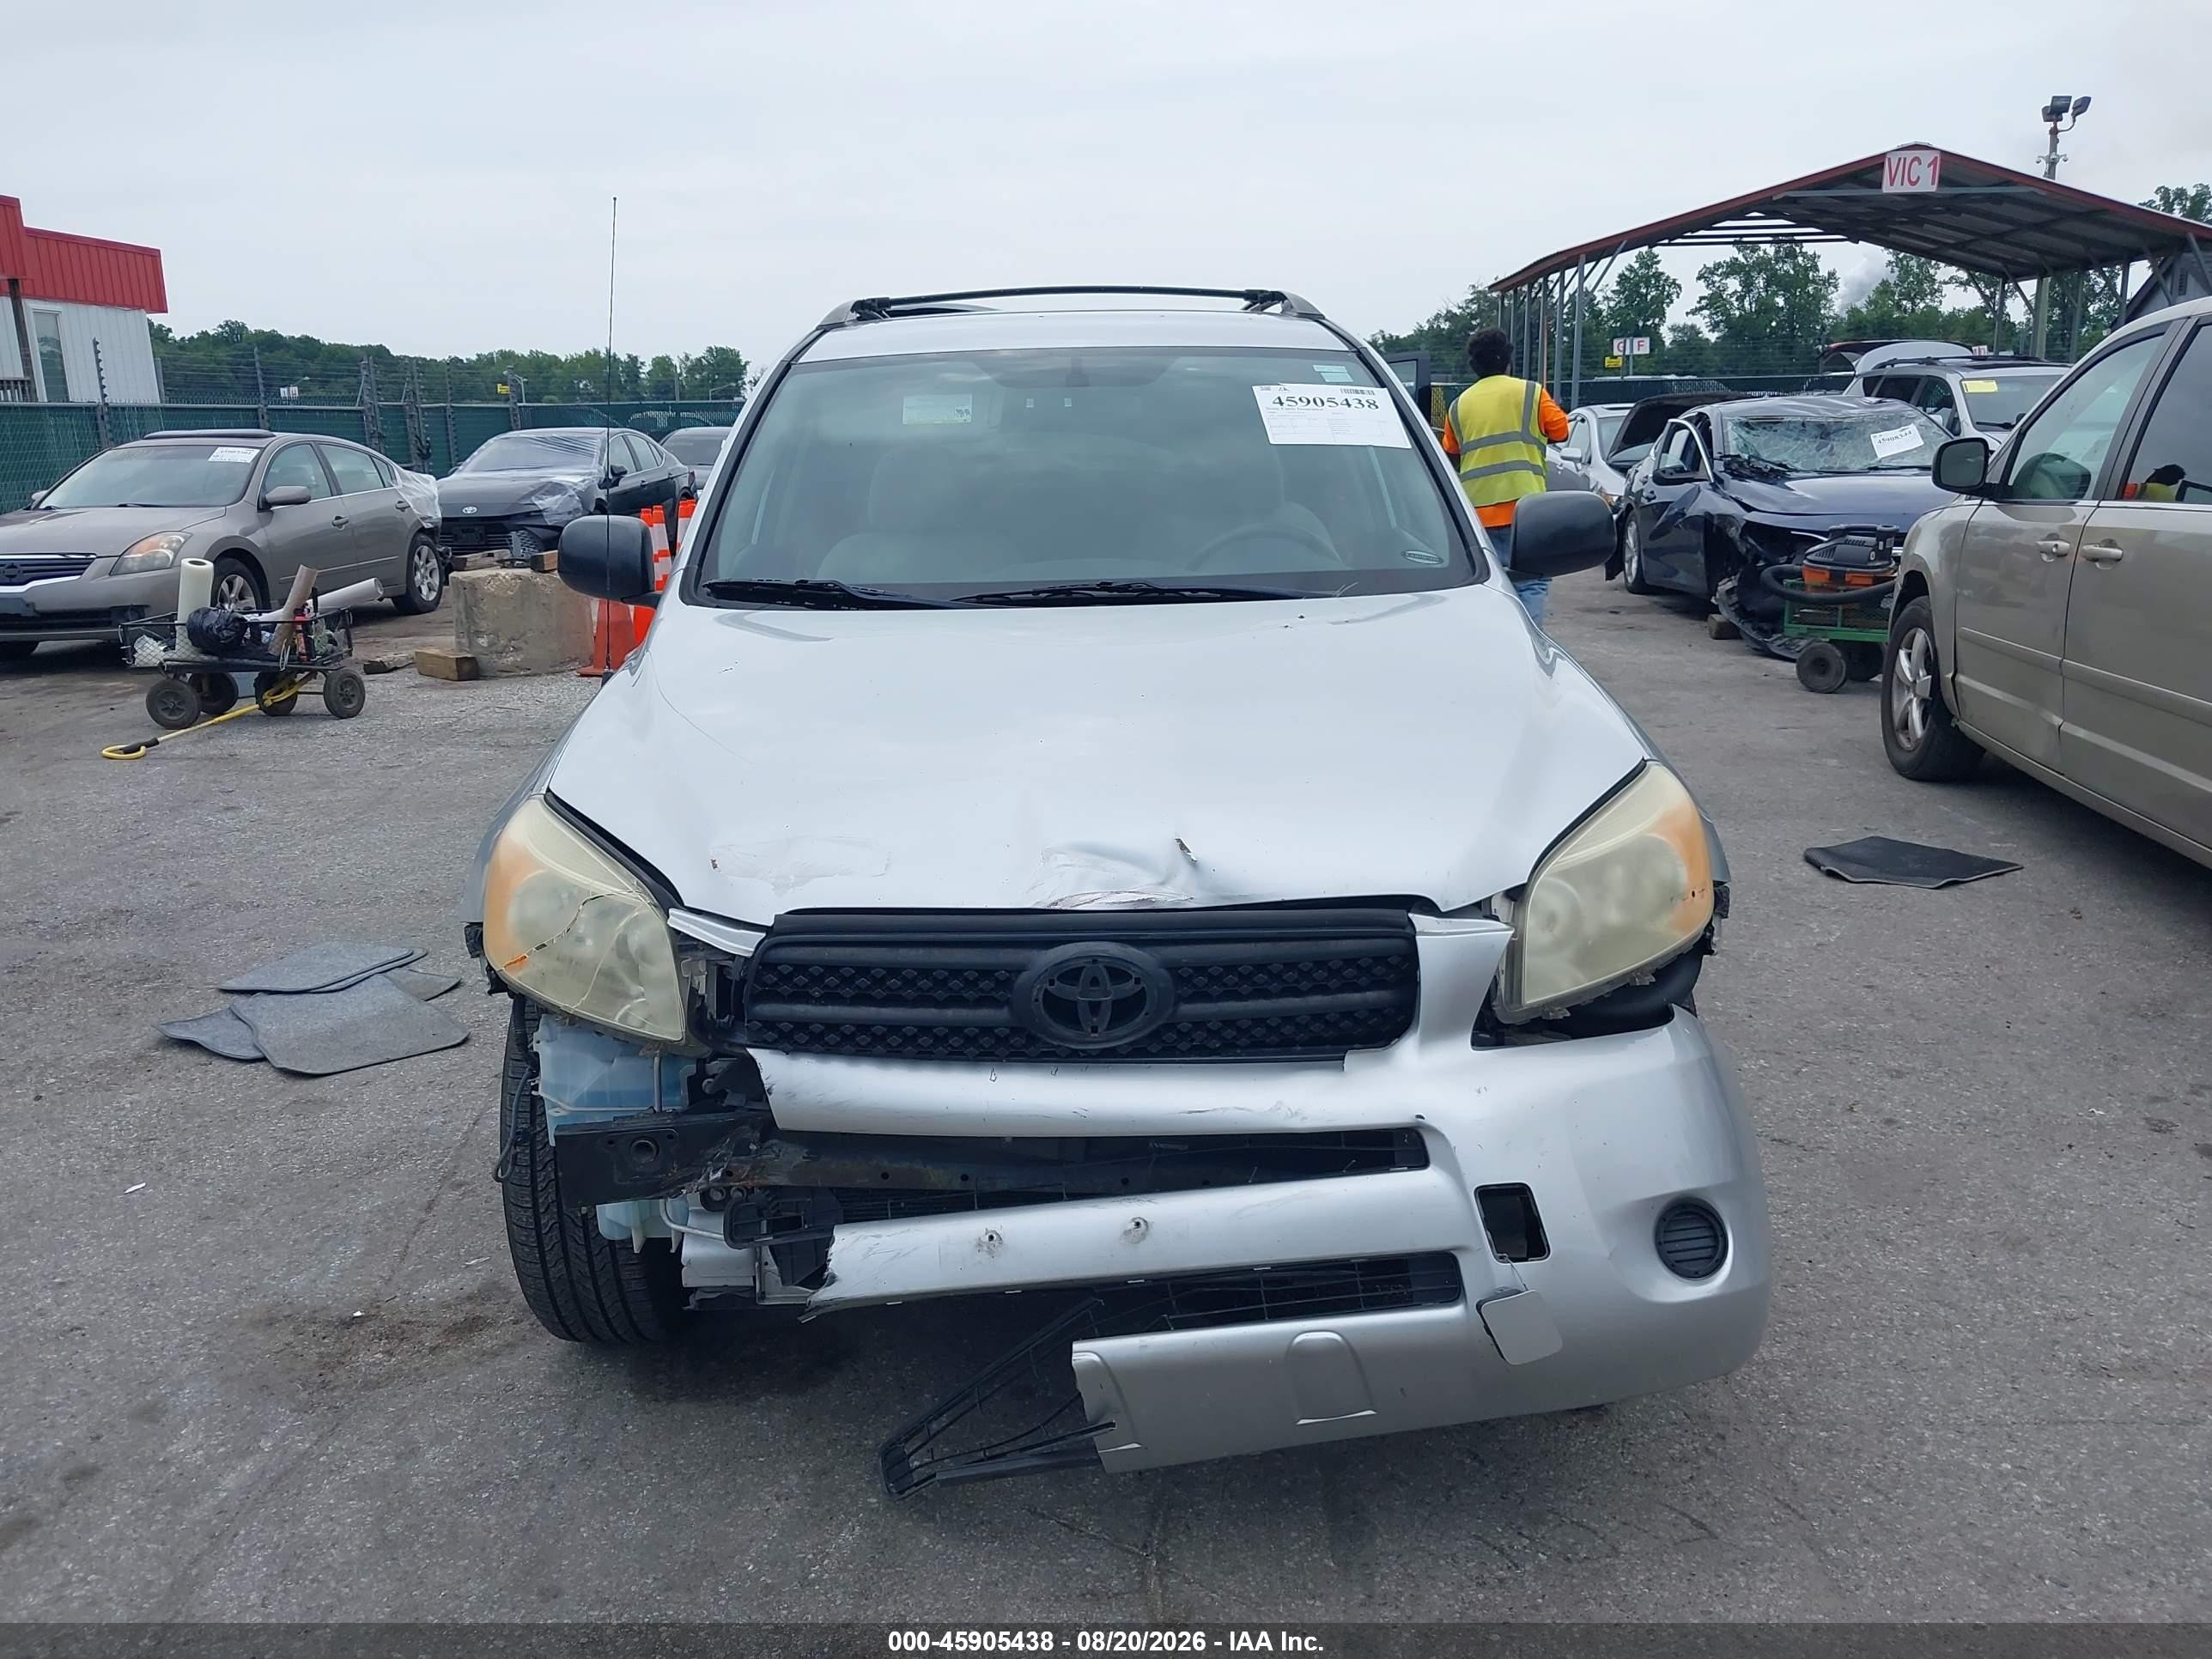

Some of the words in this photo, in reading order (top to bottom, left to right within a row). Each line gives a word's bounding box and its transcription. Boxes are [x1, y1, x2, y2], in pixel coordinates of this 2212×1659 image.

[1887, 155, 1923, 187] VIC
[1926, 155, 1939, 186] 1
[1637, 340, 1645, 351] F
[1272, 395, 1380, 410] 45905438
